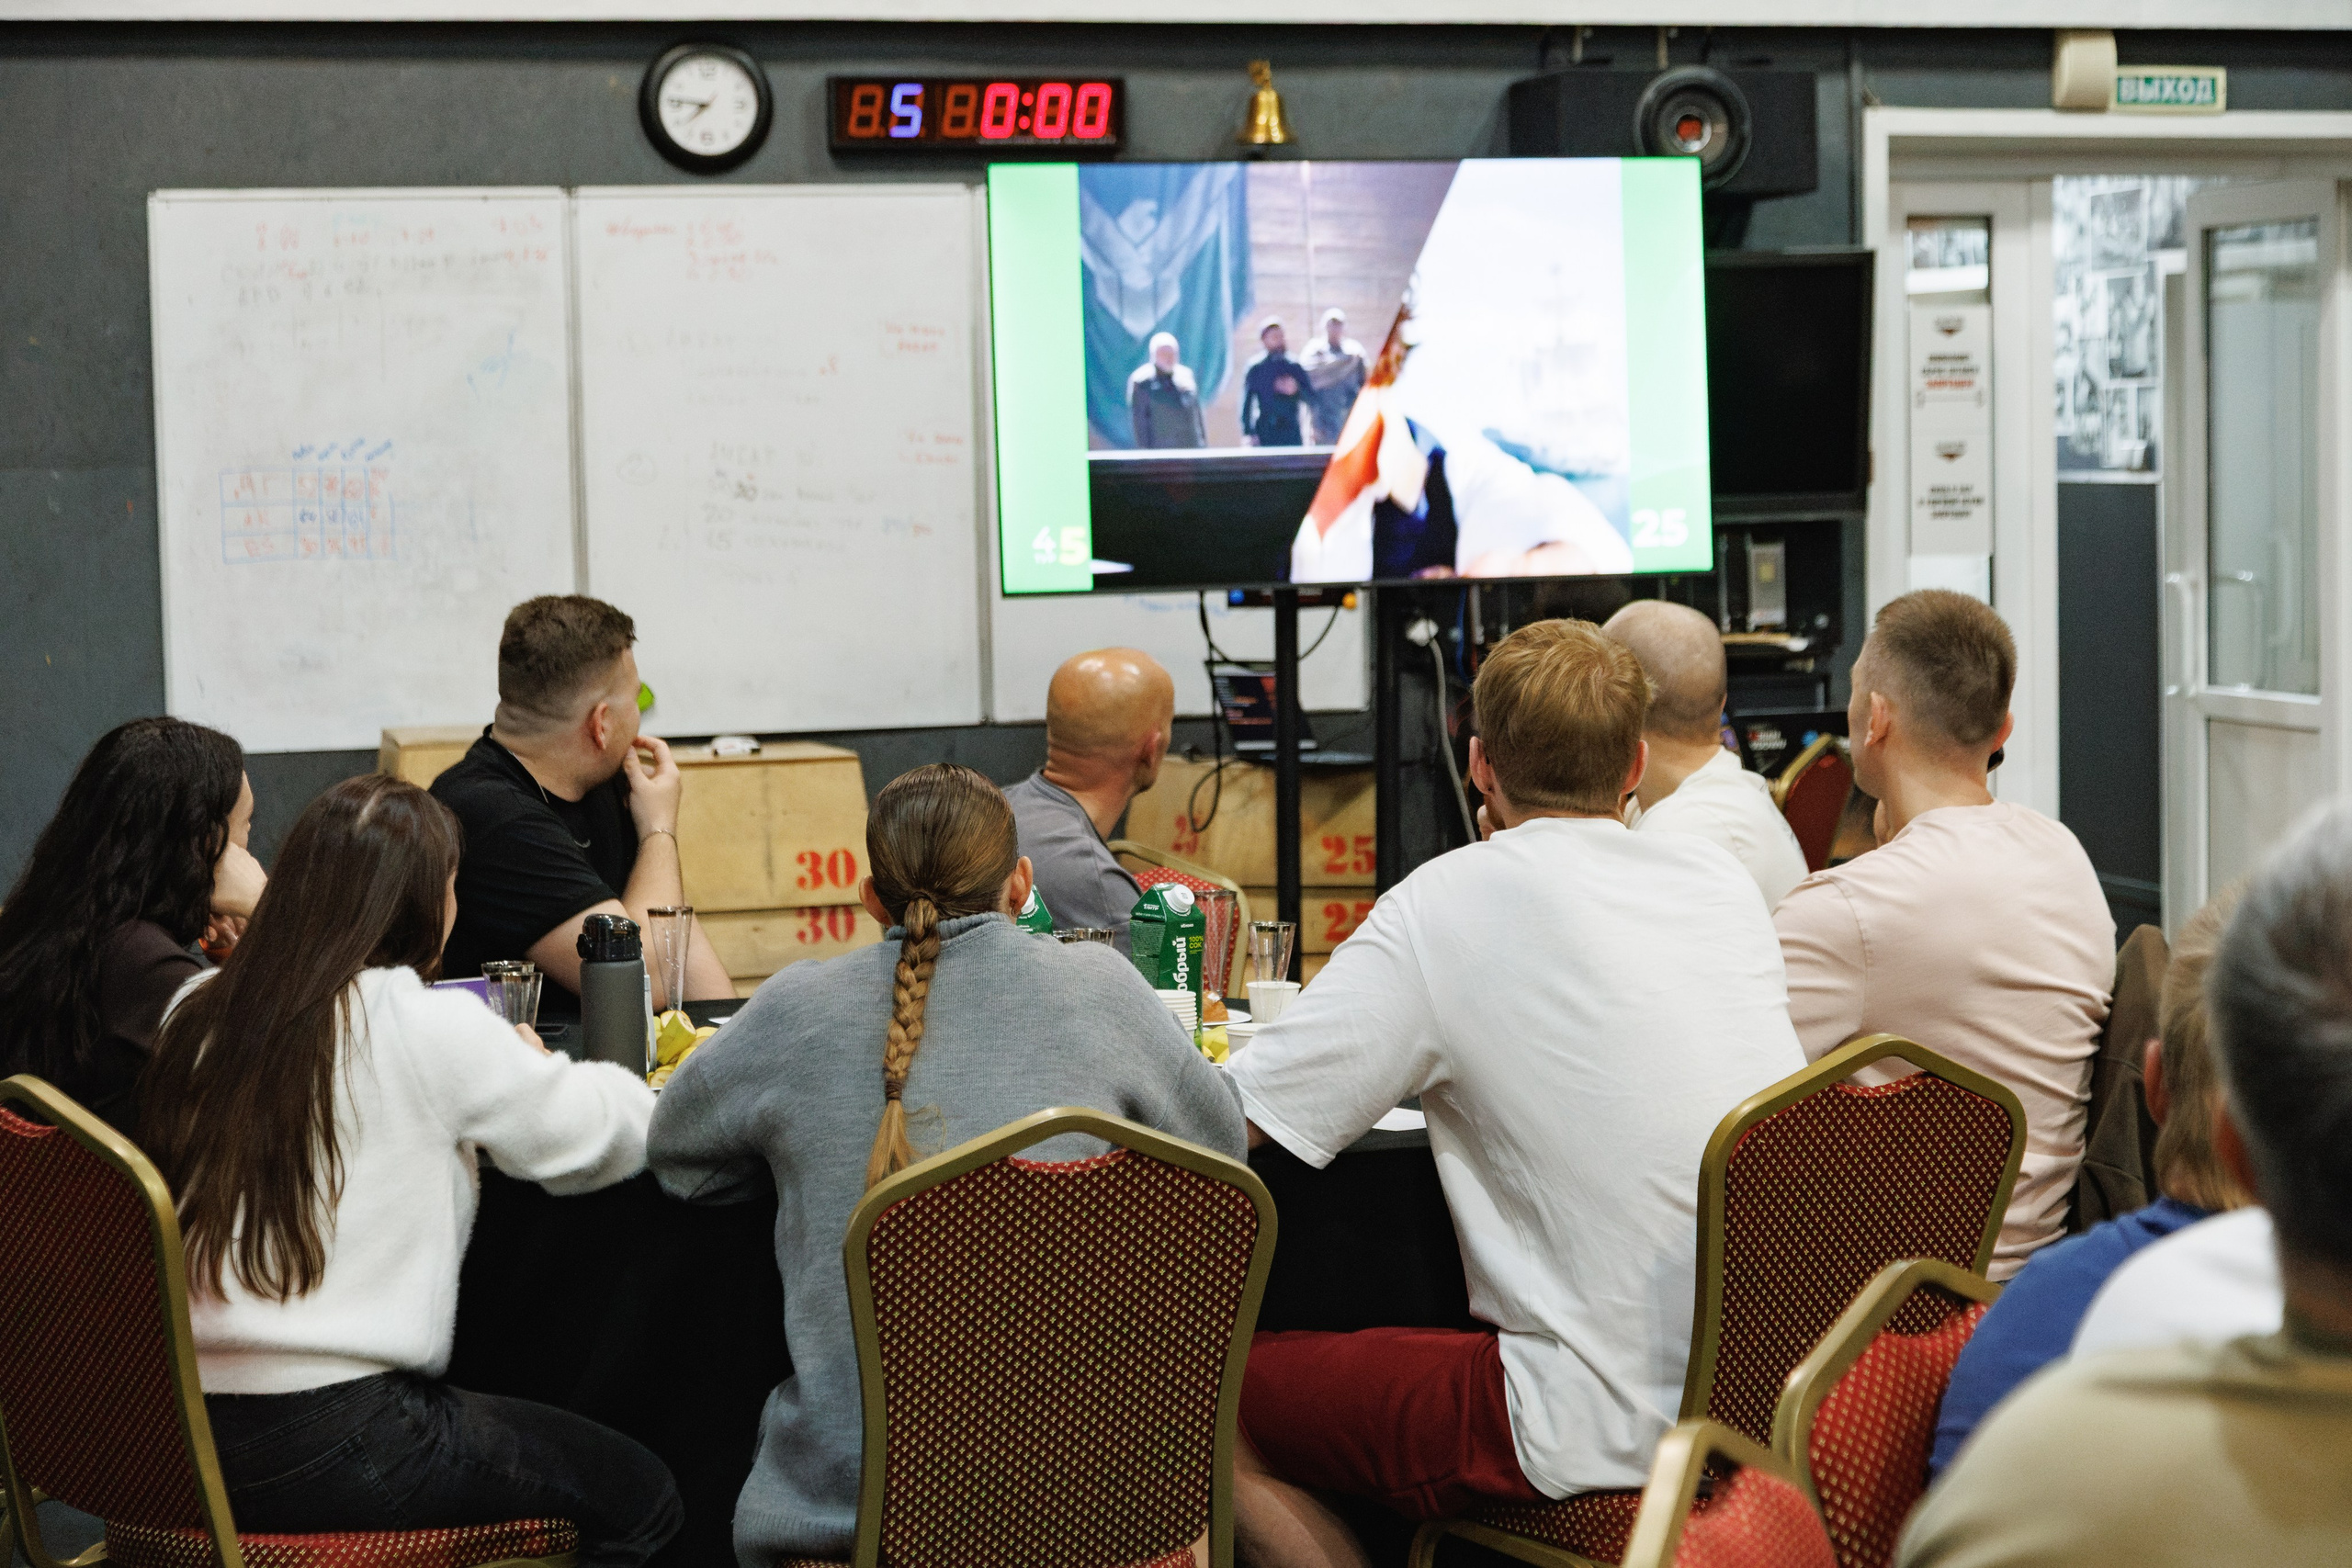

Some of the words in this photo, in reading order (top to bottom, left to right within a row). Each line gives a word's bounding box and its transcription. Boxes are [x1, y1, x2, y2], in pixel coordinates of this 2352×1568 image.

[2120, 77, 2212, 104] ВЫХОД
[980, 83, 1113, 139] 0:00
[1632, 508, 1689, 547] 25
[796, 848, 857, 890] 30
[1321, 835, 1376, 874] 25
[796, 905, 856, 944] 30
[1172, 937, 1189, 990] обрый
